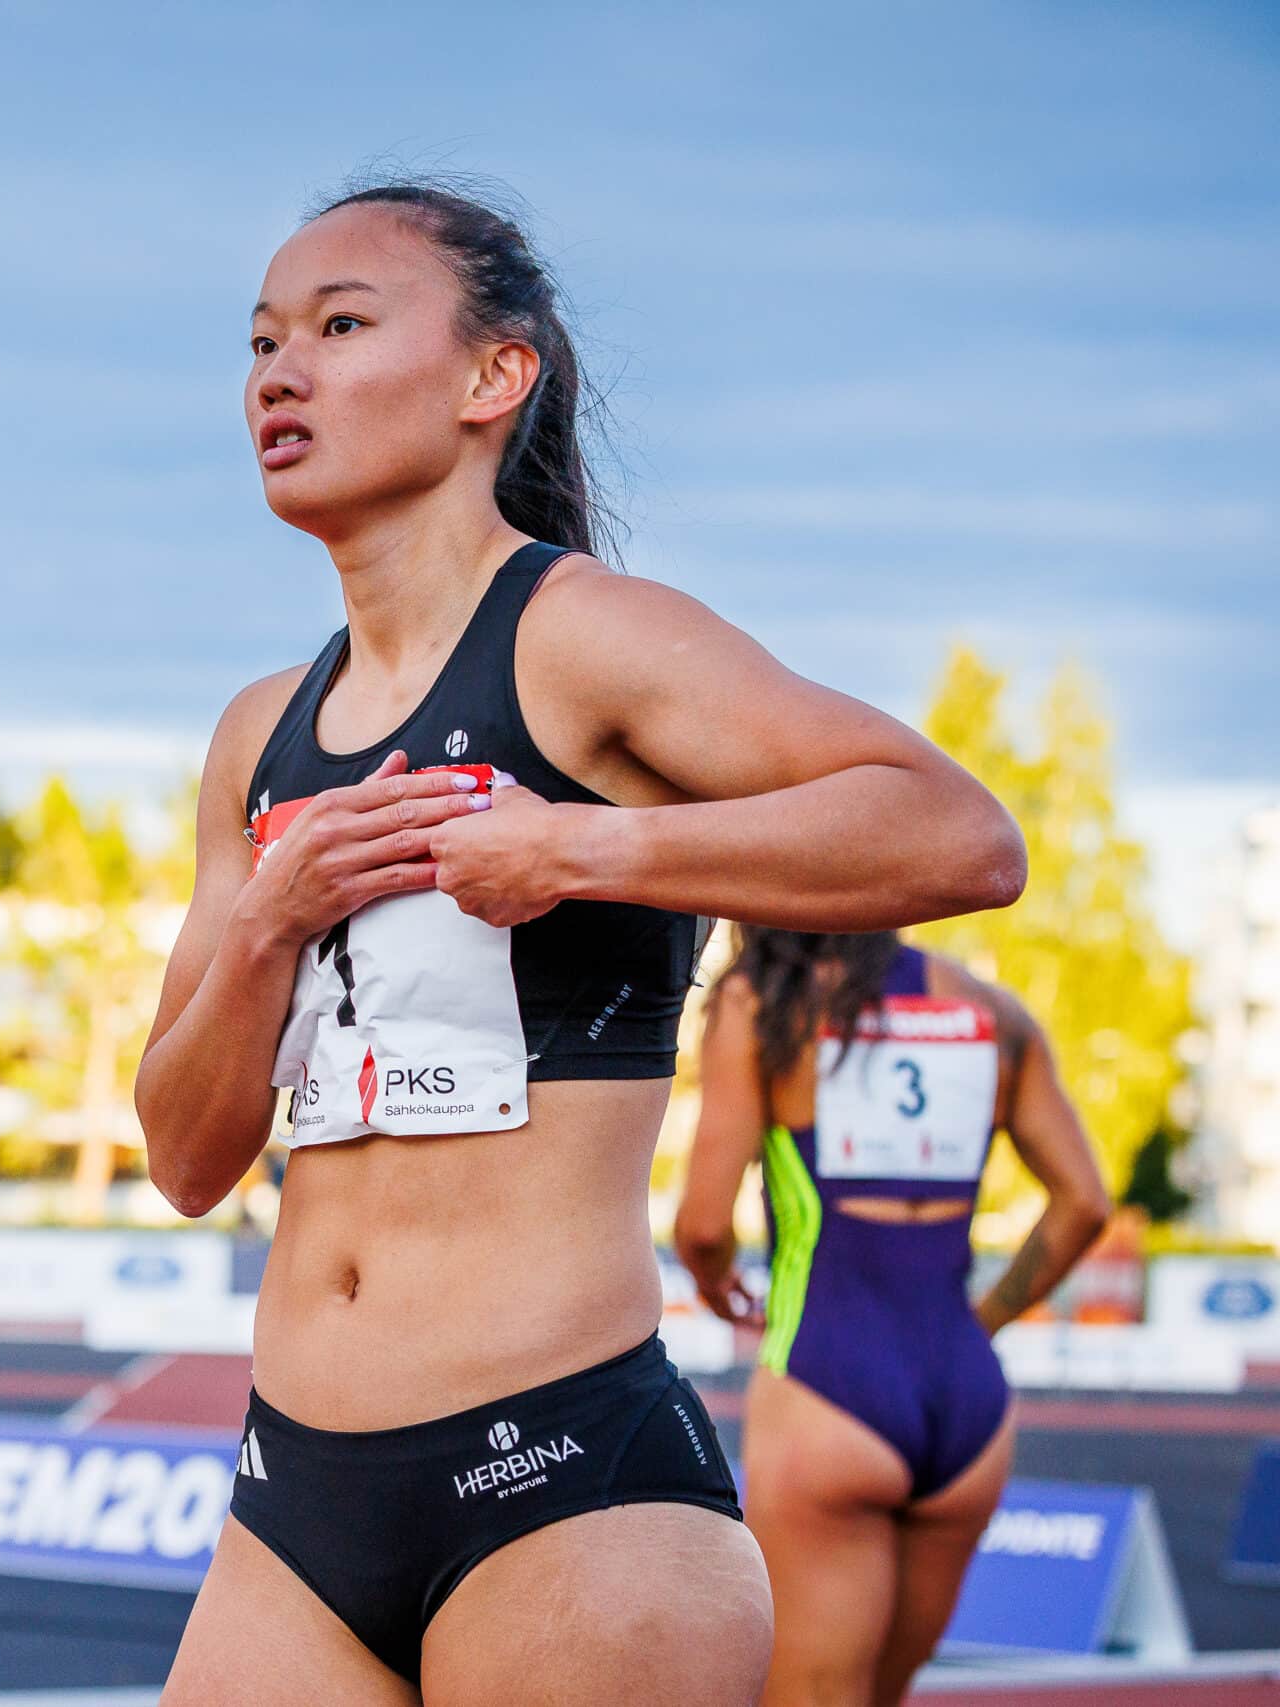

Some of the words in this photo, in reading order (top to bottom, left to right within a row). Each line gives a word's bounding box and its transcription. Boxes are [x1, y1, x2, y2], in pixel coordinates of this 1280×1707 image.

[385, 1067, 456, 1097] PKS
[893, 1057, 927, 1119] 3
[385, 1102, 475, 1118] Sähkökauppa
[673, 1403, 708, 1465] AEROREADY
[453, 1435, 585, 1499] HERBINA
[496, 1487, 509, 1499] BY
[510, 1474, 549, 1494] NATURE
